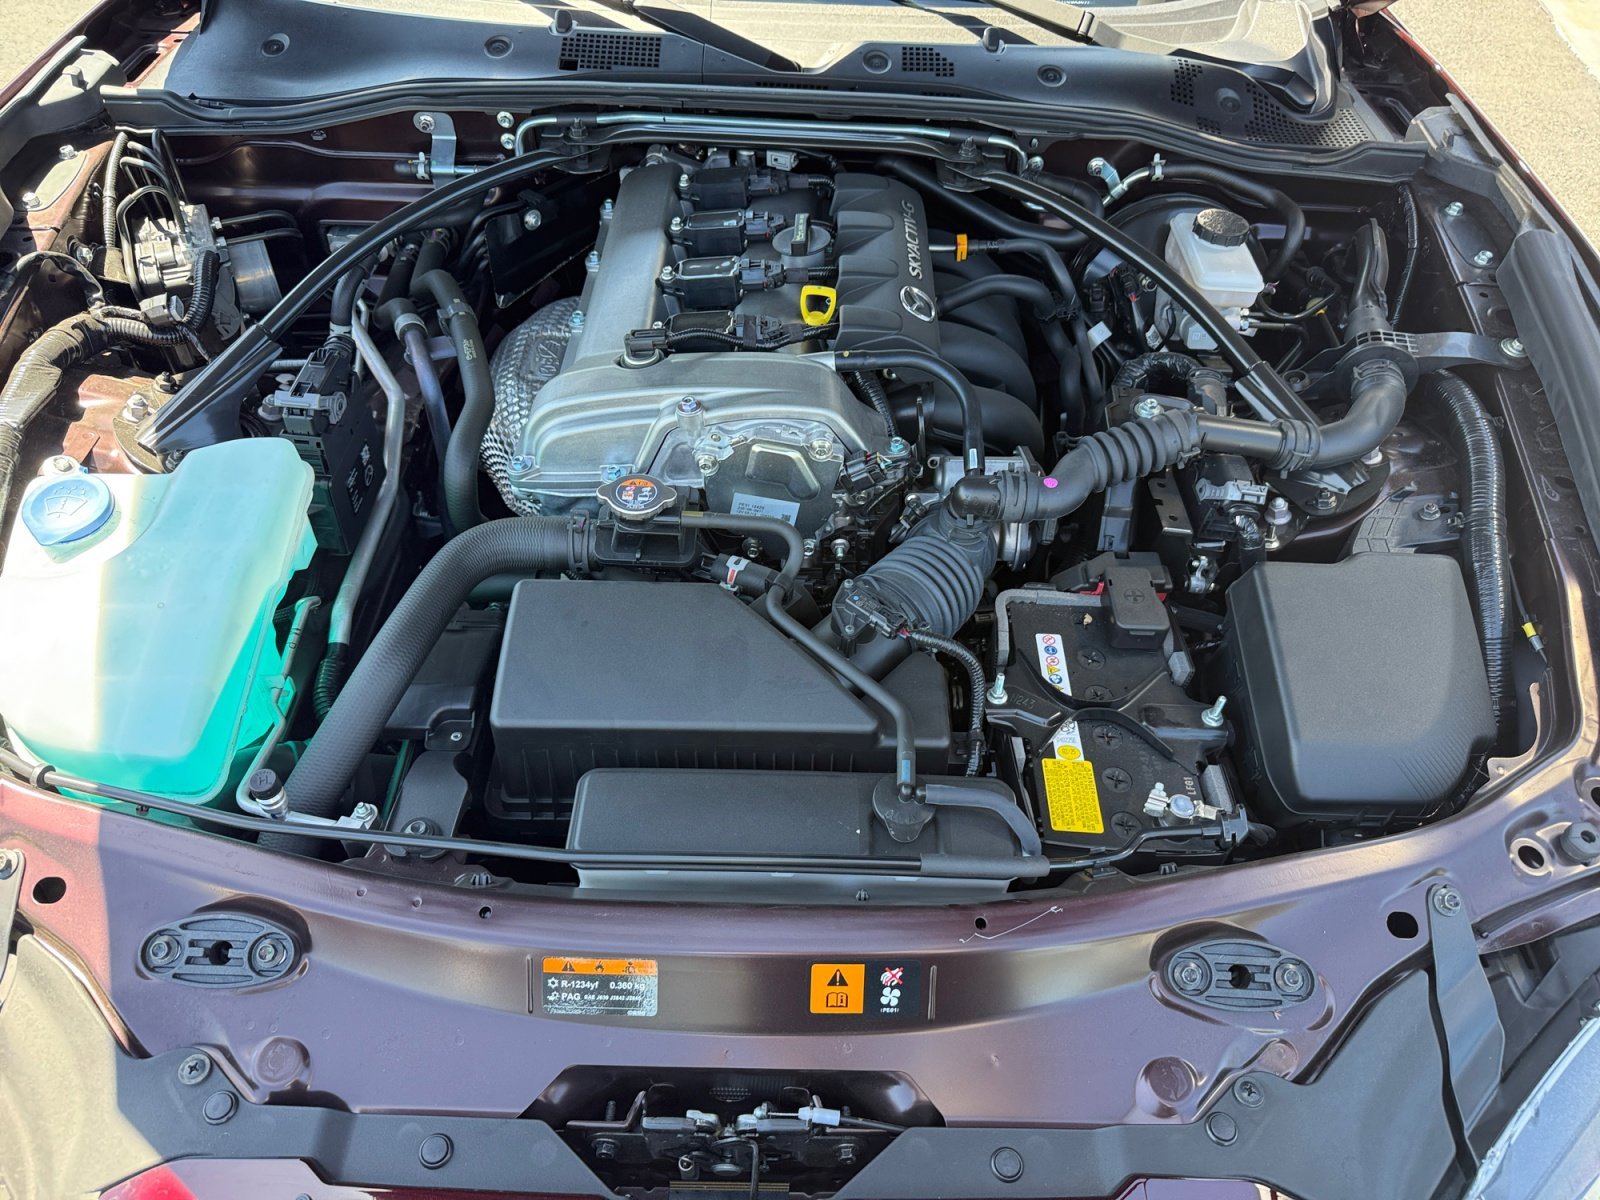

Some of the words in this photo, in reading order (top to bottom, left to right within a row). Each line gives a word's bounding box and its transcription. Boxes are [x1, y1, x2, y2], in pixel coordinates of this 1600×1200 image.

[901, 199, 922, 280] SKYACTIV-G
[560, 979, 599, 991] R-1234yf
[634, 982, 646, 992] kg
[560, 992, 581, 1001] PAG
